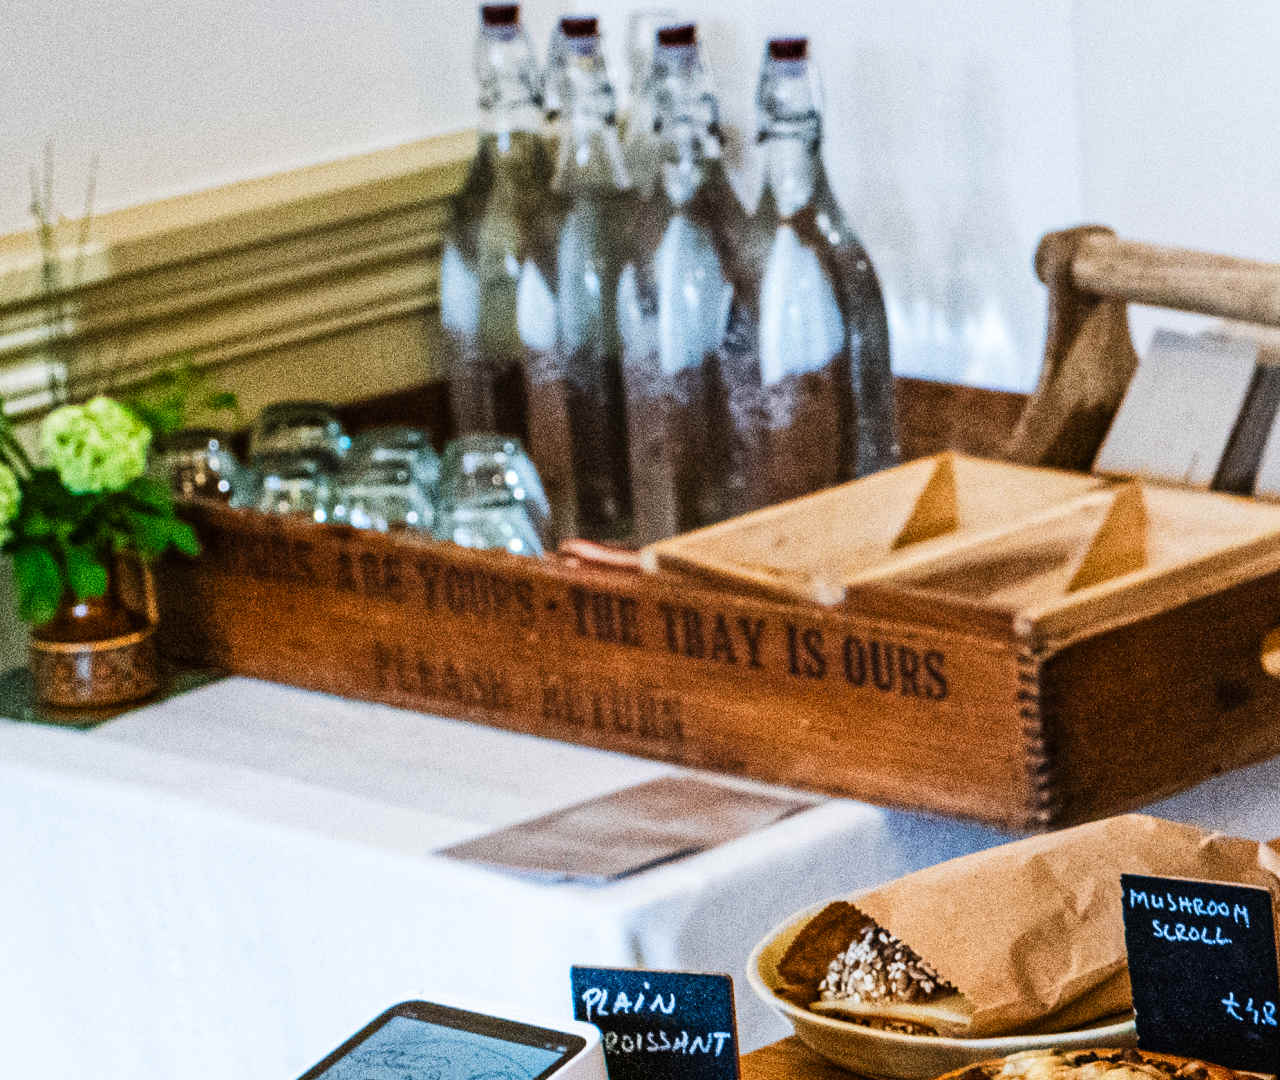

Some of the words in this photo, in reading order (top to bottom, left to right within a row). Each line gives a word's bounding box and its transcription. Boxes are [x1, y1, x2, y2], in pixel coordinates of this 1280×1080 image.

[786, 621, 828, 682] IS
[842, 633, 950, 701] OURS
[1129, 887, 1251, 929] MUSHROOM
[602, 1029, 731, 1057] ROISSANT
